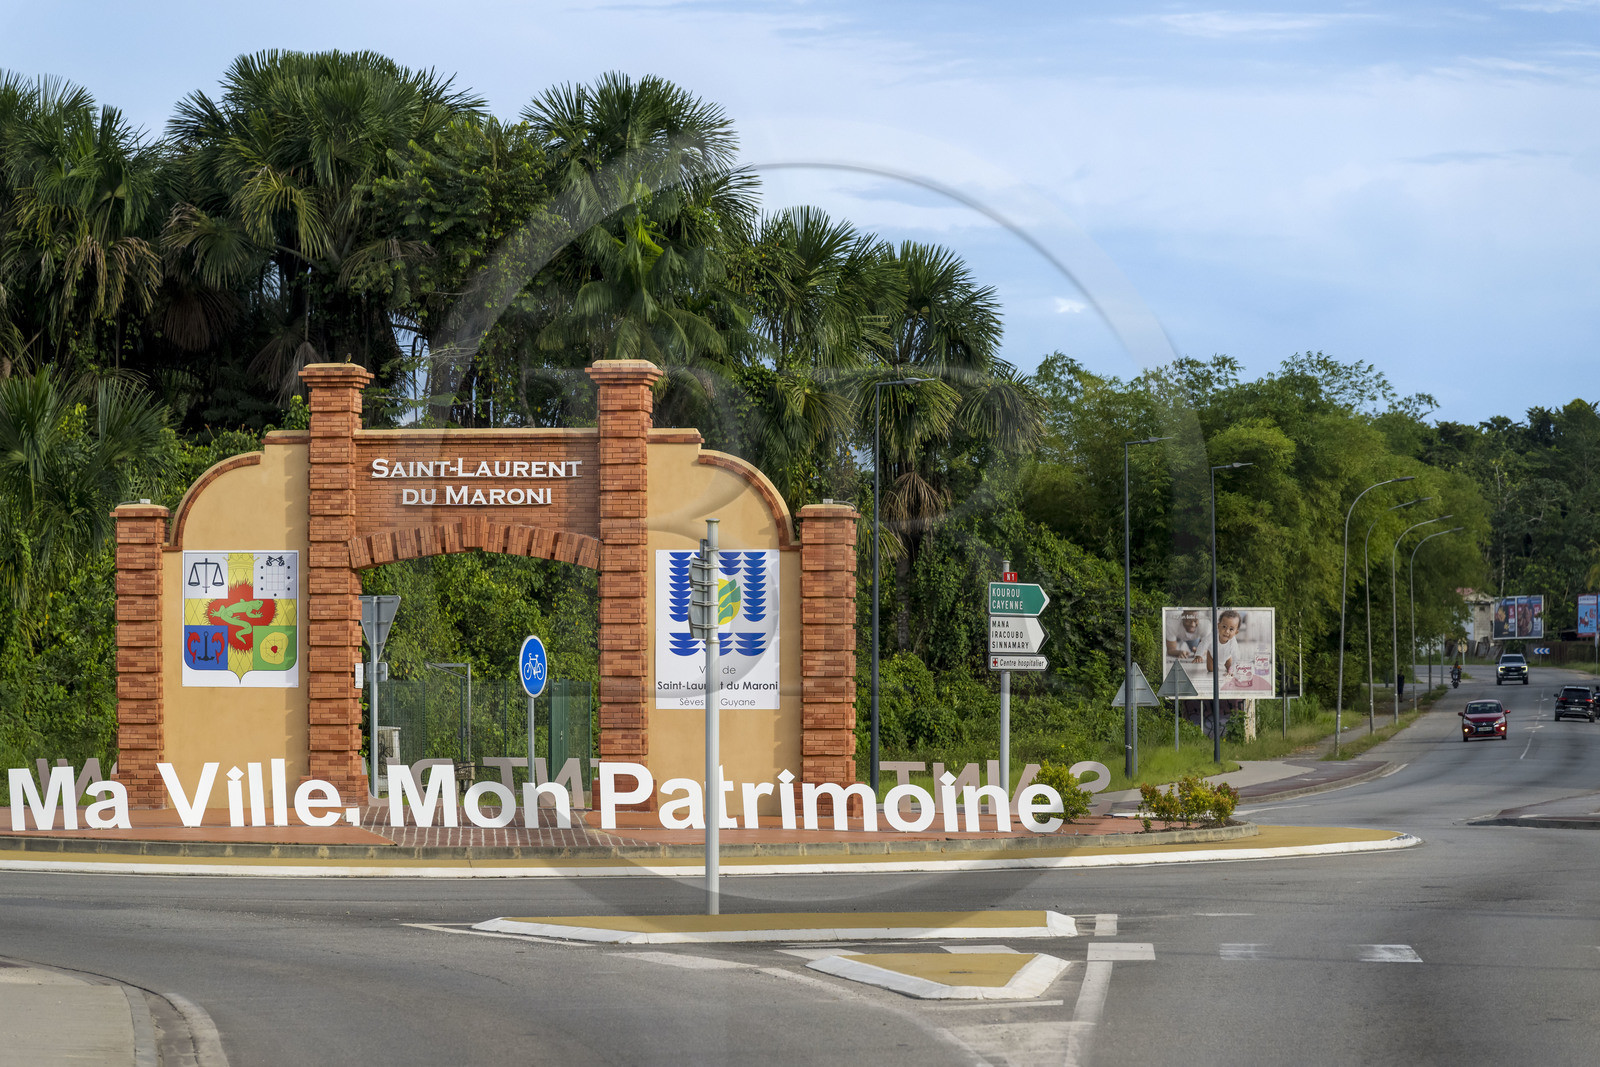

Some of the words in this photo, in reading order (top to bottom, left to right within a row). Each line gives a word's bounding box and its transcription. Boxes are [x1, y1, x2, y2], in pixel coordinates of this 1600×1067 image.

[371, 458, 583, 478] SAINT-LAURENT
[445, 485, 552, 505] MARONI
[992, 588, 1021, 598] KOUROU
[992, 600, 1024, 610] CAYENNE
[992, 620, 1010, 628] MANA
[992, 630, 1024, 639] IRACOUBO
[992, 641, 1030, 650] SINNAMARY
[999, 658, 1016, 667] Centre
[1018, 657, 1045, 668] hospitalier
[722, 665, 737, 675] de
[657, 681, 724, 690] Saint-Laut
[726, 681, 740, 690] du
[742, 681, 778, 690] Maroni
[679, 697, 704, 706] Sèves
[720, 697, 756, 708] Guyane
[8, 766, 132, 832] Ma
[387, 764, 572, 829] Mon
[598, 762, 1065, 833] Patrimoine
